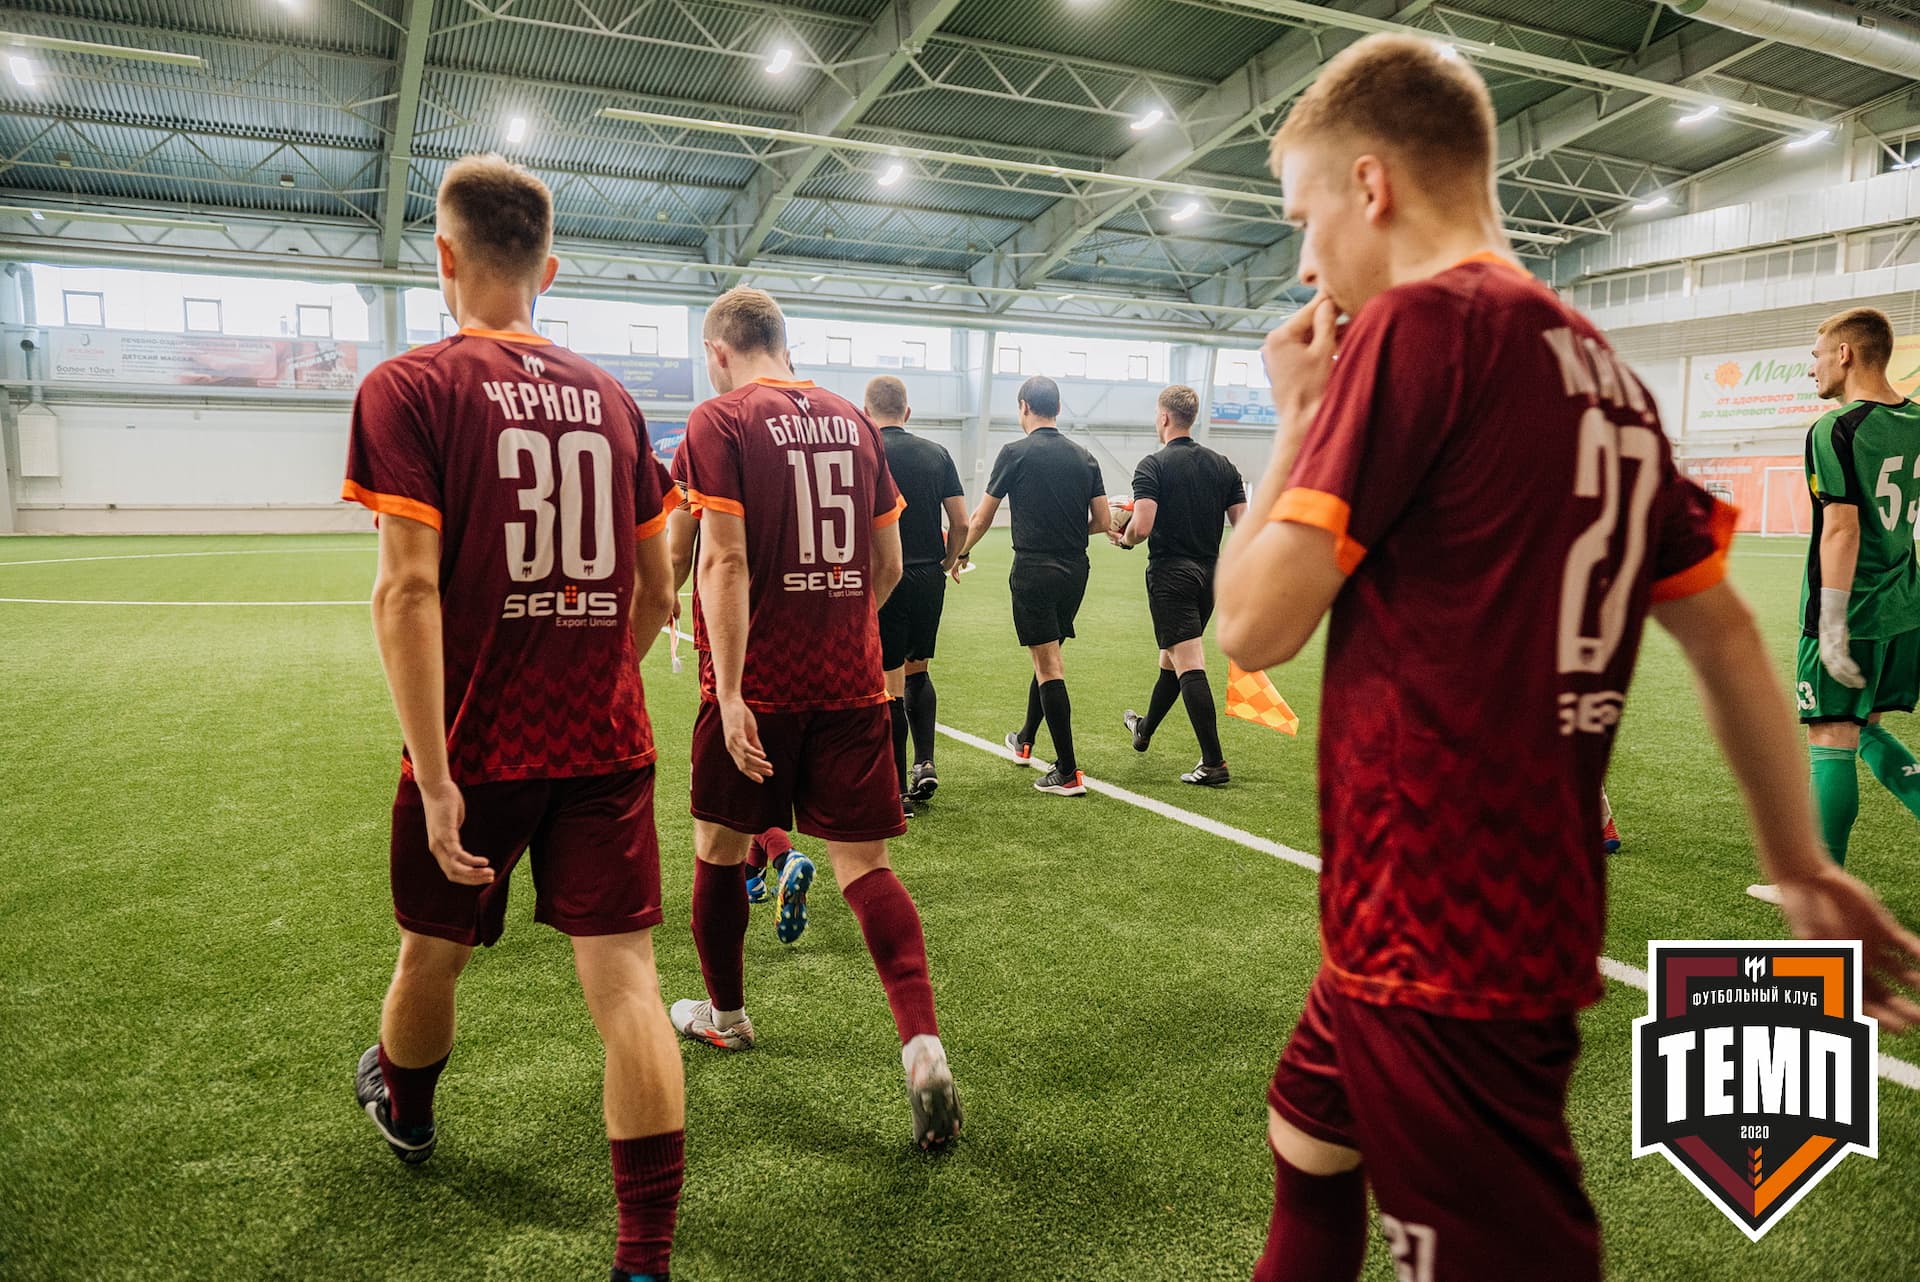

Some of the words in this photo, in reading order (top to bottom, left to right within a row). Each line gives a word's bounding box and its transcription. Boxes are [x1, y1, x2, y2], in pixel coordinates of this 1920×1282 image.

[482, 381, 602, 425] ЧЕРНОВ
[765, 415, 860, 446] БЕЛИКОВ
[497, 427, 616, 582] 30
[787, 449, 855, 564] 15
[1556, 406, 1661, 674] 27
[556, 617, 588, 628] Export
[589, 617, 618, 627] Union
